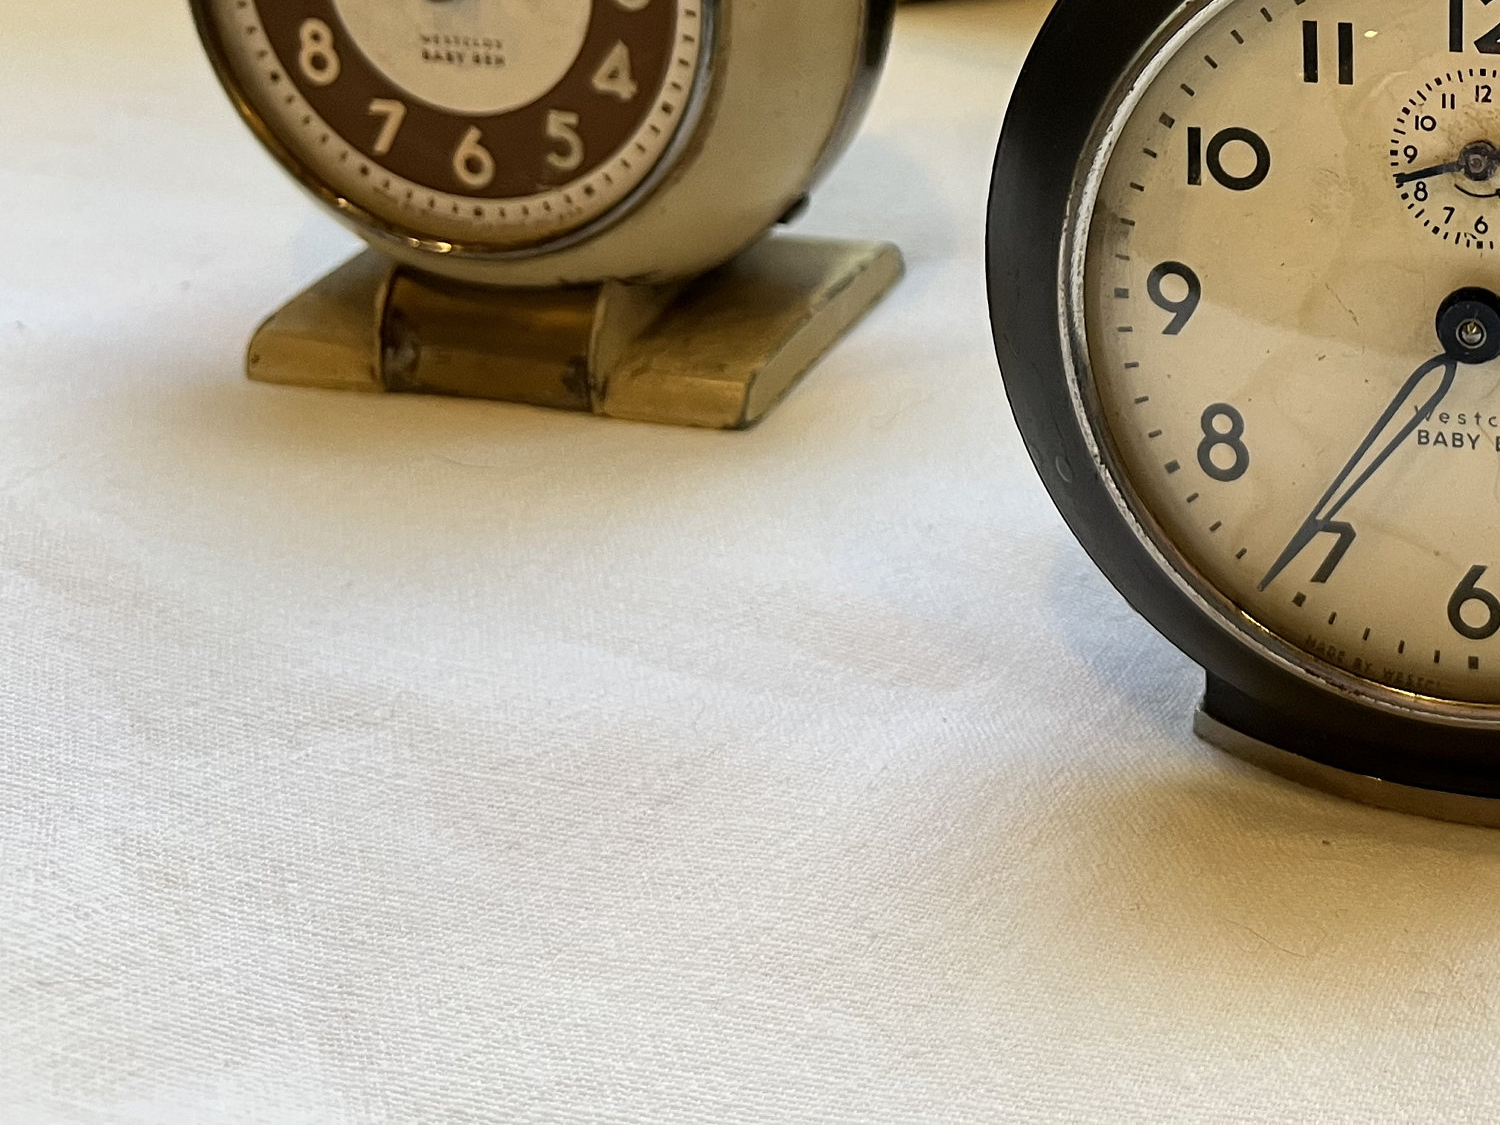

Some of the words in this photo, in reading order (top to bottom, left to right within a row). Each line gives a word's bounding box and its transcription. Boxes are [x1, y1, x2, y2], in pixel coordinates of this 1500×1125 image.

[300, 17, 341, 85] 8
[591, 39, 639, 100] 4
[1301, 20, 1355, 86] 11
[1441, 93, 1456, 110] 11
[1475, 84, 1492, 103] 12
[367, 99, 408, 154] 7
[545, 109, 585, 170] 5
[1414, 115, 1437, 132] 10
[452, 125, 495, 191] 6
[1186, 125, 1272, 191] 10
[1403, 145, 1418, 164] 9
[1413, 181, 1428, 202] 8
[1442, 206, 1456, 224] 7
[1474, 215, 1488, 234] 6
[1145, 260, 1202, 337] 9
[1197, 402, 1251, 482] 8
[1417, 429, 1480, 450] BABY
[1309, 519, 1357, 585] 7
